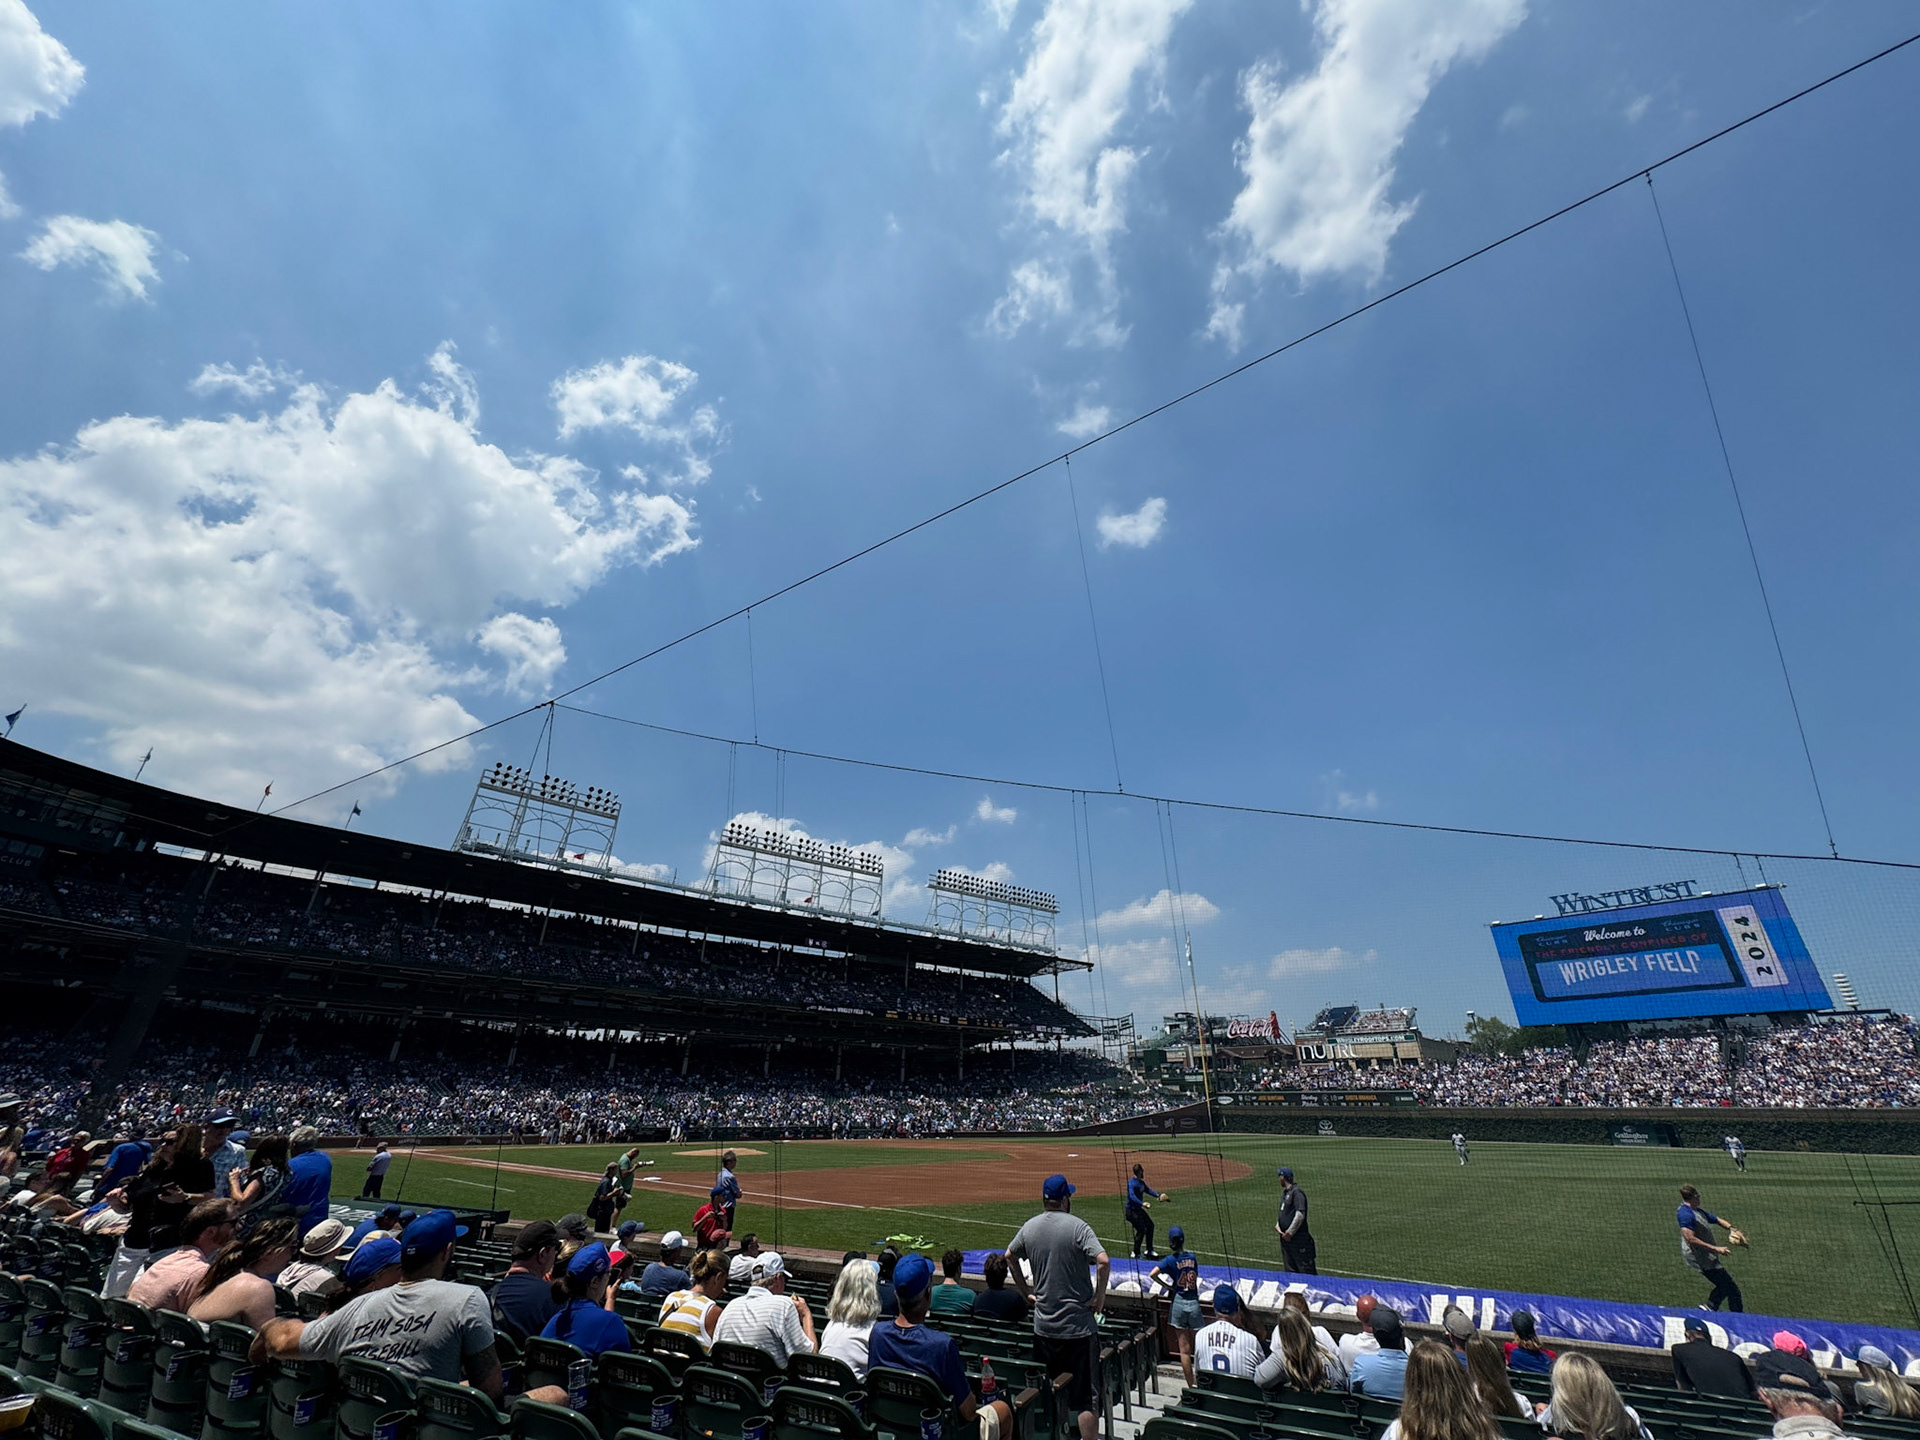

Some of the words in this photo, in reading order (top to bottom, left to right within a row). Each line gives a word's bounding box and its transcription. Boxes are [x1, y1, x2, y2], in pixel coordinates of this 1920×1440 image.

[1549, 880, 1698, 913] WINTRUST
[1583, 927, 1632, 942] Welcome
[1633, 926, 1646, 936] to
[1733, 916, 1773, 976] 2024
[1558, 955, 1638, 985] WRIGLEY
[1227, 1017, 1274, 1040] Coca-Cola
[353, 1316, 392, 1341] TEAM
[391, 1311, 437, 1335] SOSA
[1207, 1331, 1237, 1349] HAPP
